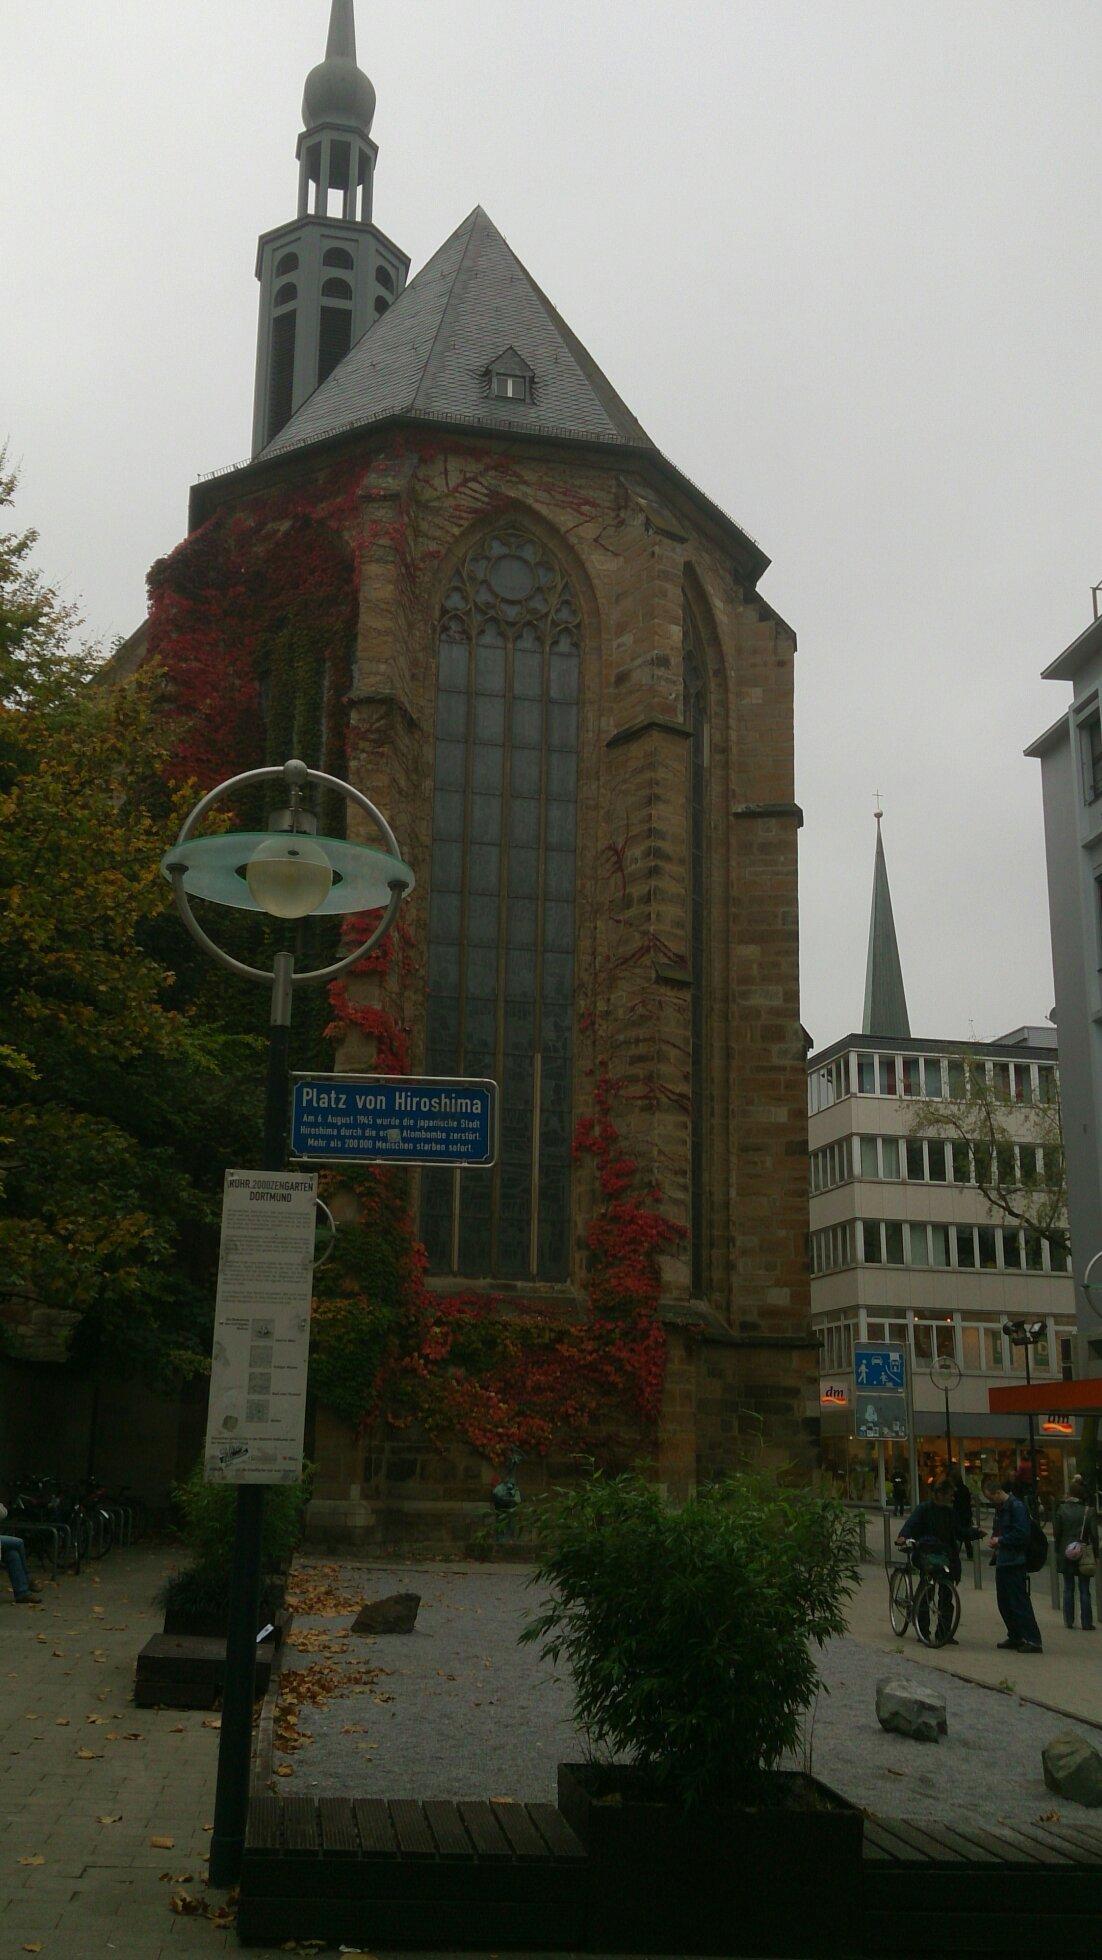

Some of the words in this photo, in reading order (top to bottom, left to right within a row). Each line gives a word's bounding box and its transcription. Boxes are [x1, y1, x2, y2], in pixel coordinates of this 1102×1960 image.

[302, 1087, 347, 1109] Platz
[356, 1095, 386, 1110] von
[395, 1091, 482, 1114] Hiroshima
[302, 1113, 315, 1123] Am
[327, 1114, 353, 1125] August
[357, 1115, 373, 1124] 1945
[376, 1116, 400, 1126] wurde
[402, 1118, 415, 1126] die
[417, 1118, 458, 1128] japanische
[460, 1119, 480, 1129] Stadt
[300, 1125, 338, 1136] Hiroshima
[340, 1127, 362, 1137] durch
[364, 1128, 376, 1137] die
[402, 1130, 447, 1140] Atombombe
[307, 1137, 327, 1147] Mehr
[329, 1138, 342, 1148] als
[375, 1139, 413, 1150] Menschen
[416, 1141, 446, 1151] starben
[249, 1191, 292, 1203] DORTMUND
[825, 1385, 844, 1398] dm
